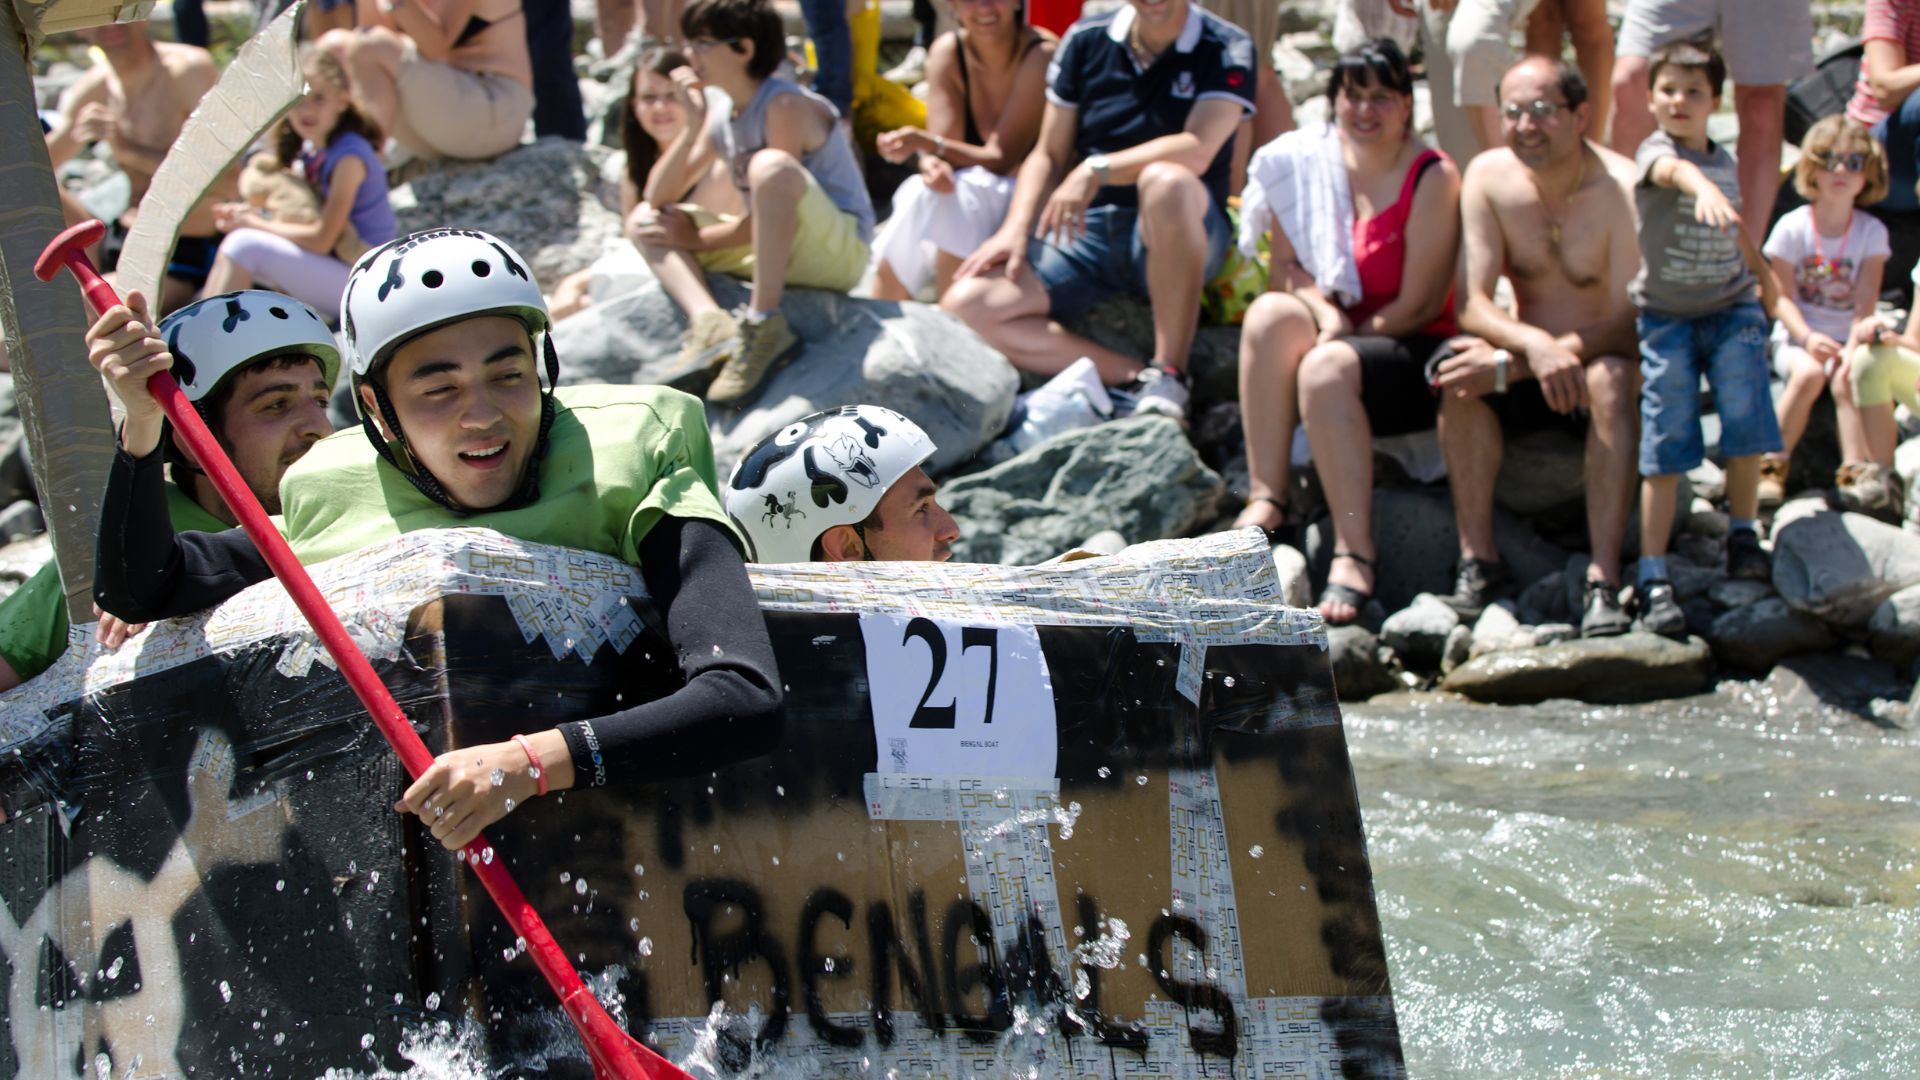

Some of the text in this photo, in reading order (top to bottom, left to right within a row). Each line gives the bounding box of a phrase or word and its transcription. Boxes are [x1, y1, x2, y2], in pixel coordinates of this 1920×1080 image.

[469, 552, 535, 574] ORO
[568, 566, 631, 588] ORO
[1161, 573, 1199, 584] CAST
[1244, 582, 1275, 599] CAST
[1189, 610, 1229, 620] CAST
[1194, 622, 1236, 635] ORO
[902, 617, 998, 729] 27
[960, 740, 984, 748] BENGAL
[960, 793, 1011, 808] ORO
[1176, 807, 1188, 879] ORO
[1187, 809, 1197, 878] CAST
[1211, 799, 1229, 870] CAST
[1197, 827, 1211, 897] ORO
[1226, 907, 1243, 978] CAST
[683, 876, 1237, 1060] BENGALS
[1125, 1060, 1171, 1073] CAST
[1263, 1060, 1305, 1074] CAST
